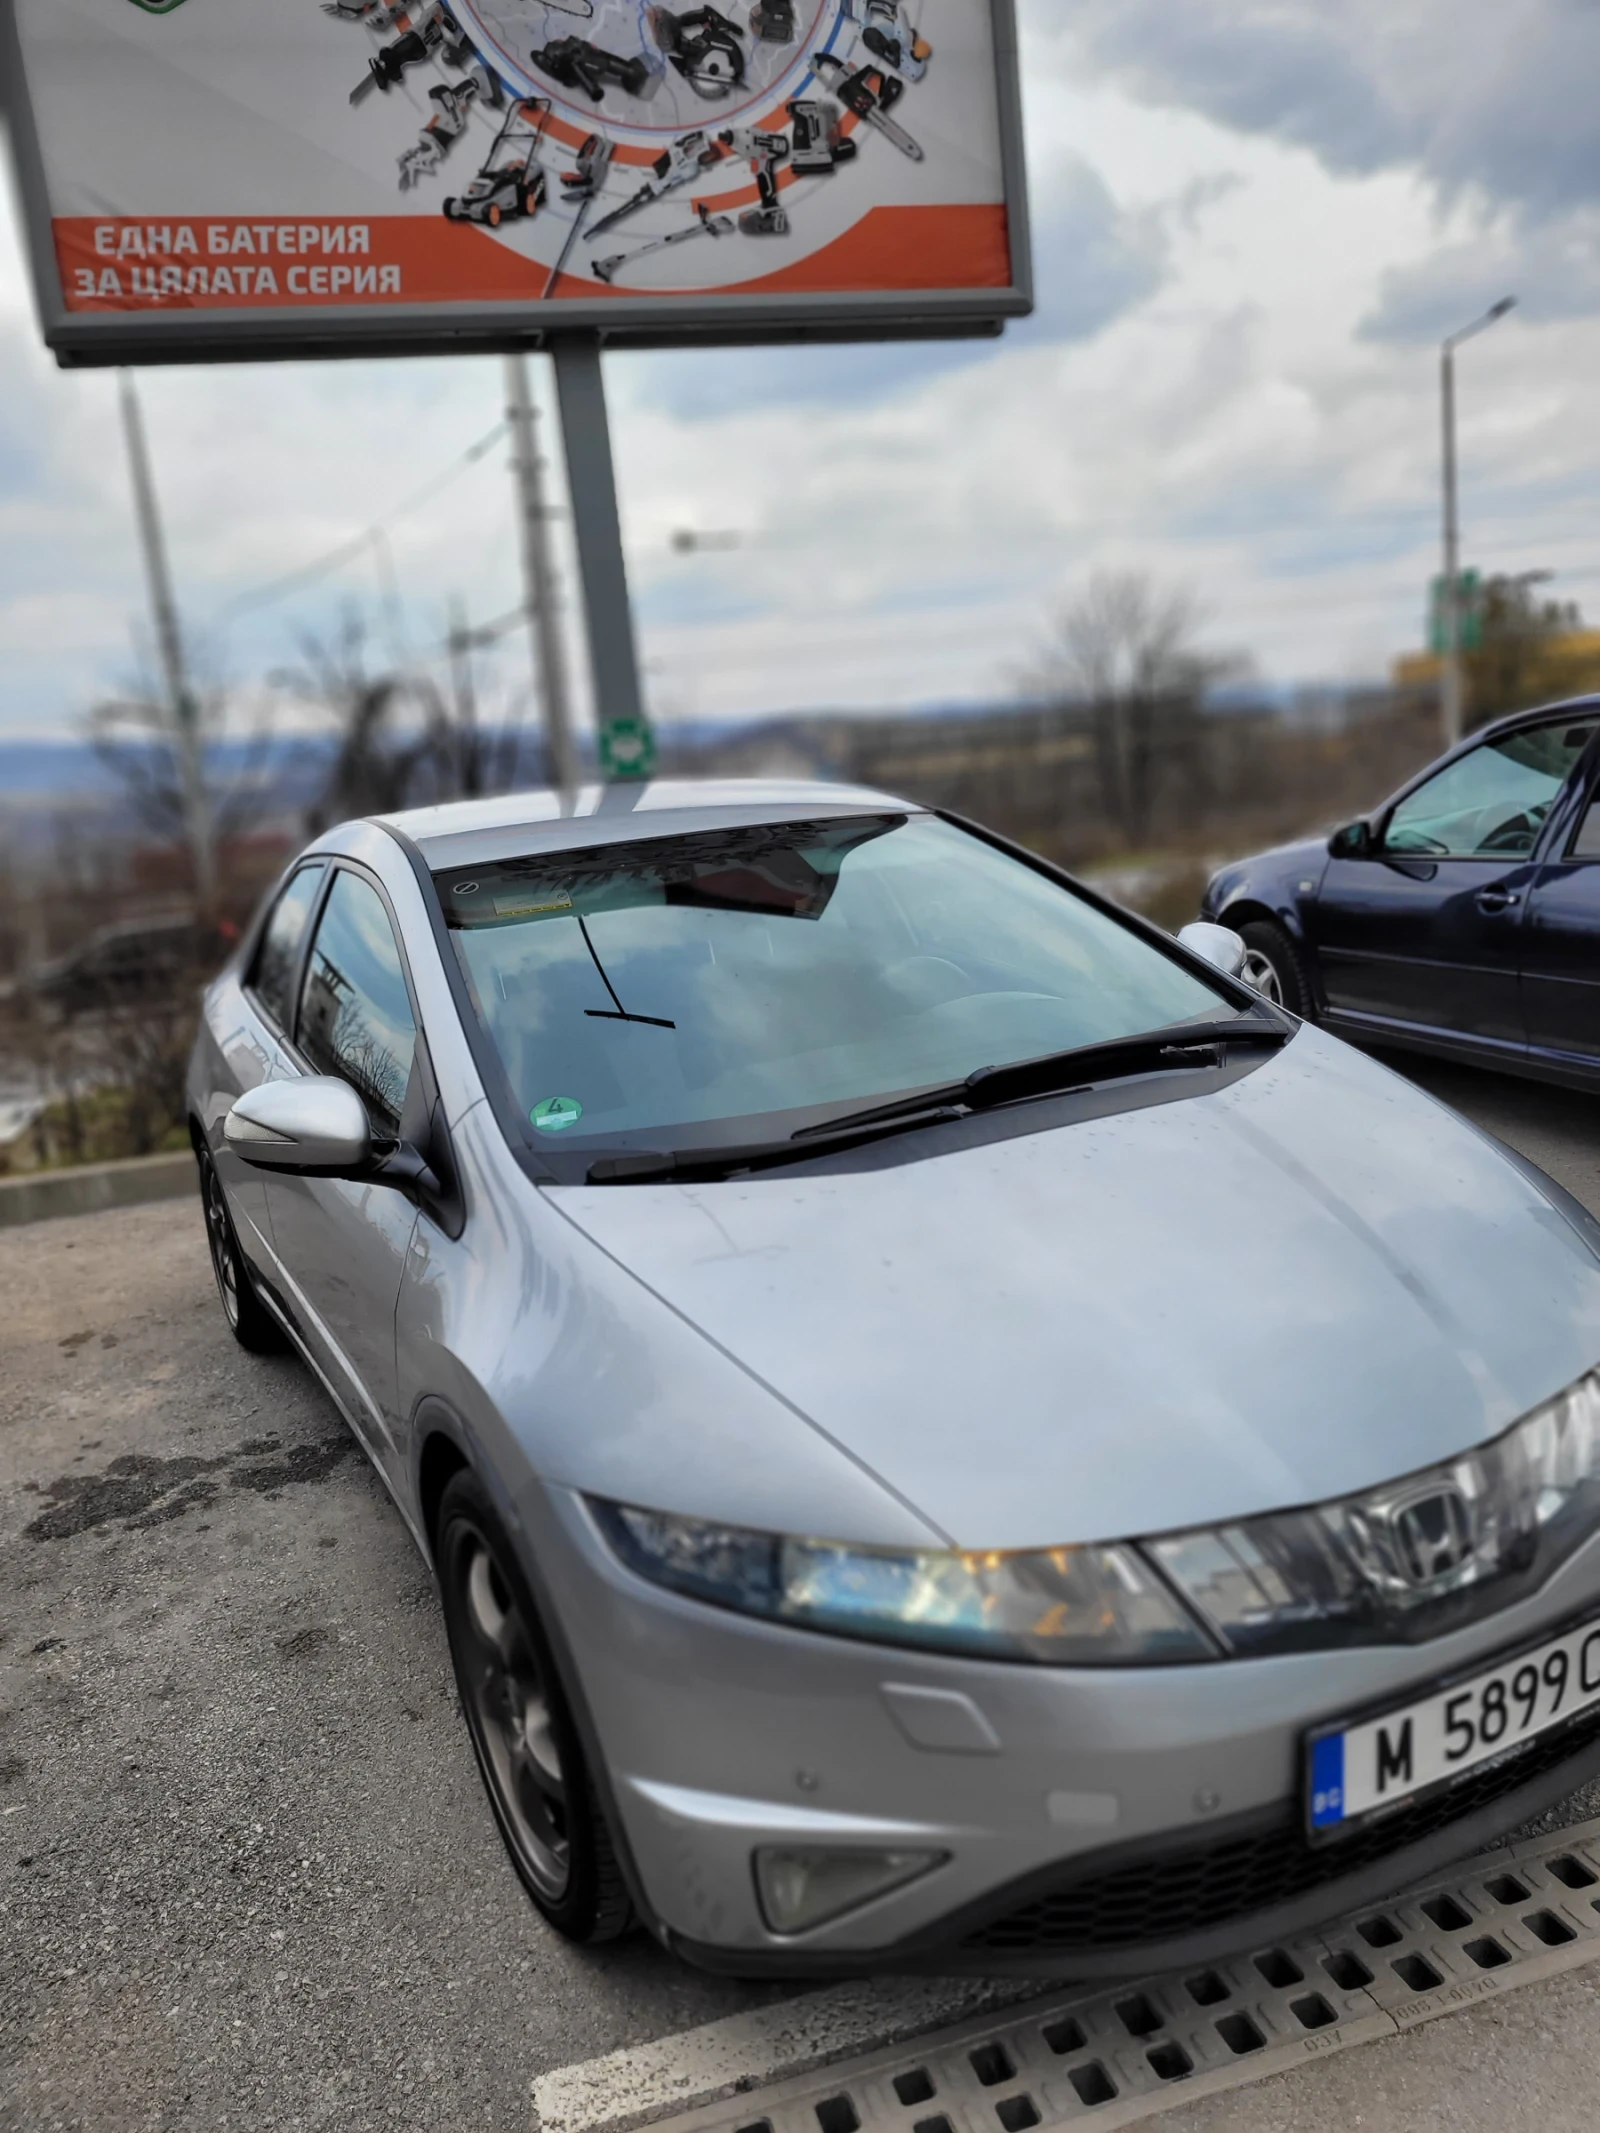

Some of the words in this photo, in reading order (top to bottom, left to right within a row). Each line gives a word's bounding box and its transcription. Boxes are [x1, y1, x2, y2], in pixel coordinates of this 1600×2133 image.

[94, 225, 199, 260] ЕДНА
[207, 225, 370, 254] БАТЕРИЯ
[74, 267, 123, 297] ЗА
[131, 265, 279, 300] ЦЯЛАТА
[286, 264, 401, 294] СЕРИЯ
[548, 1098, 563, 1113] 4
[1376, 1716, 1413, 1794] M
[1444, 1649, 1569, 1762] 5899
